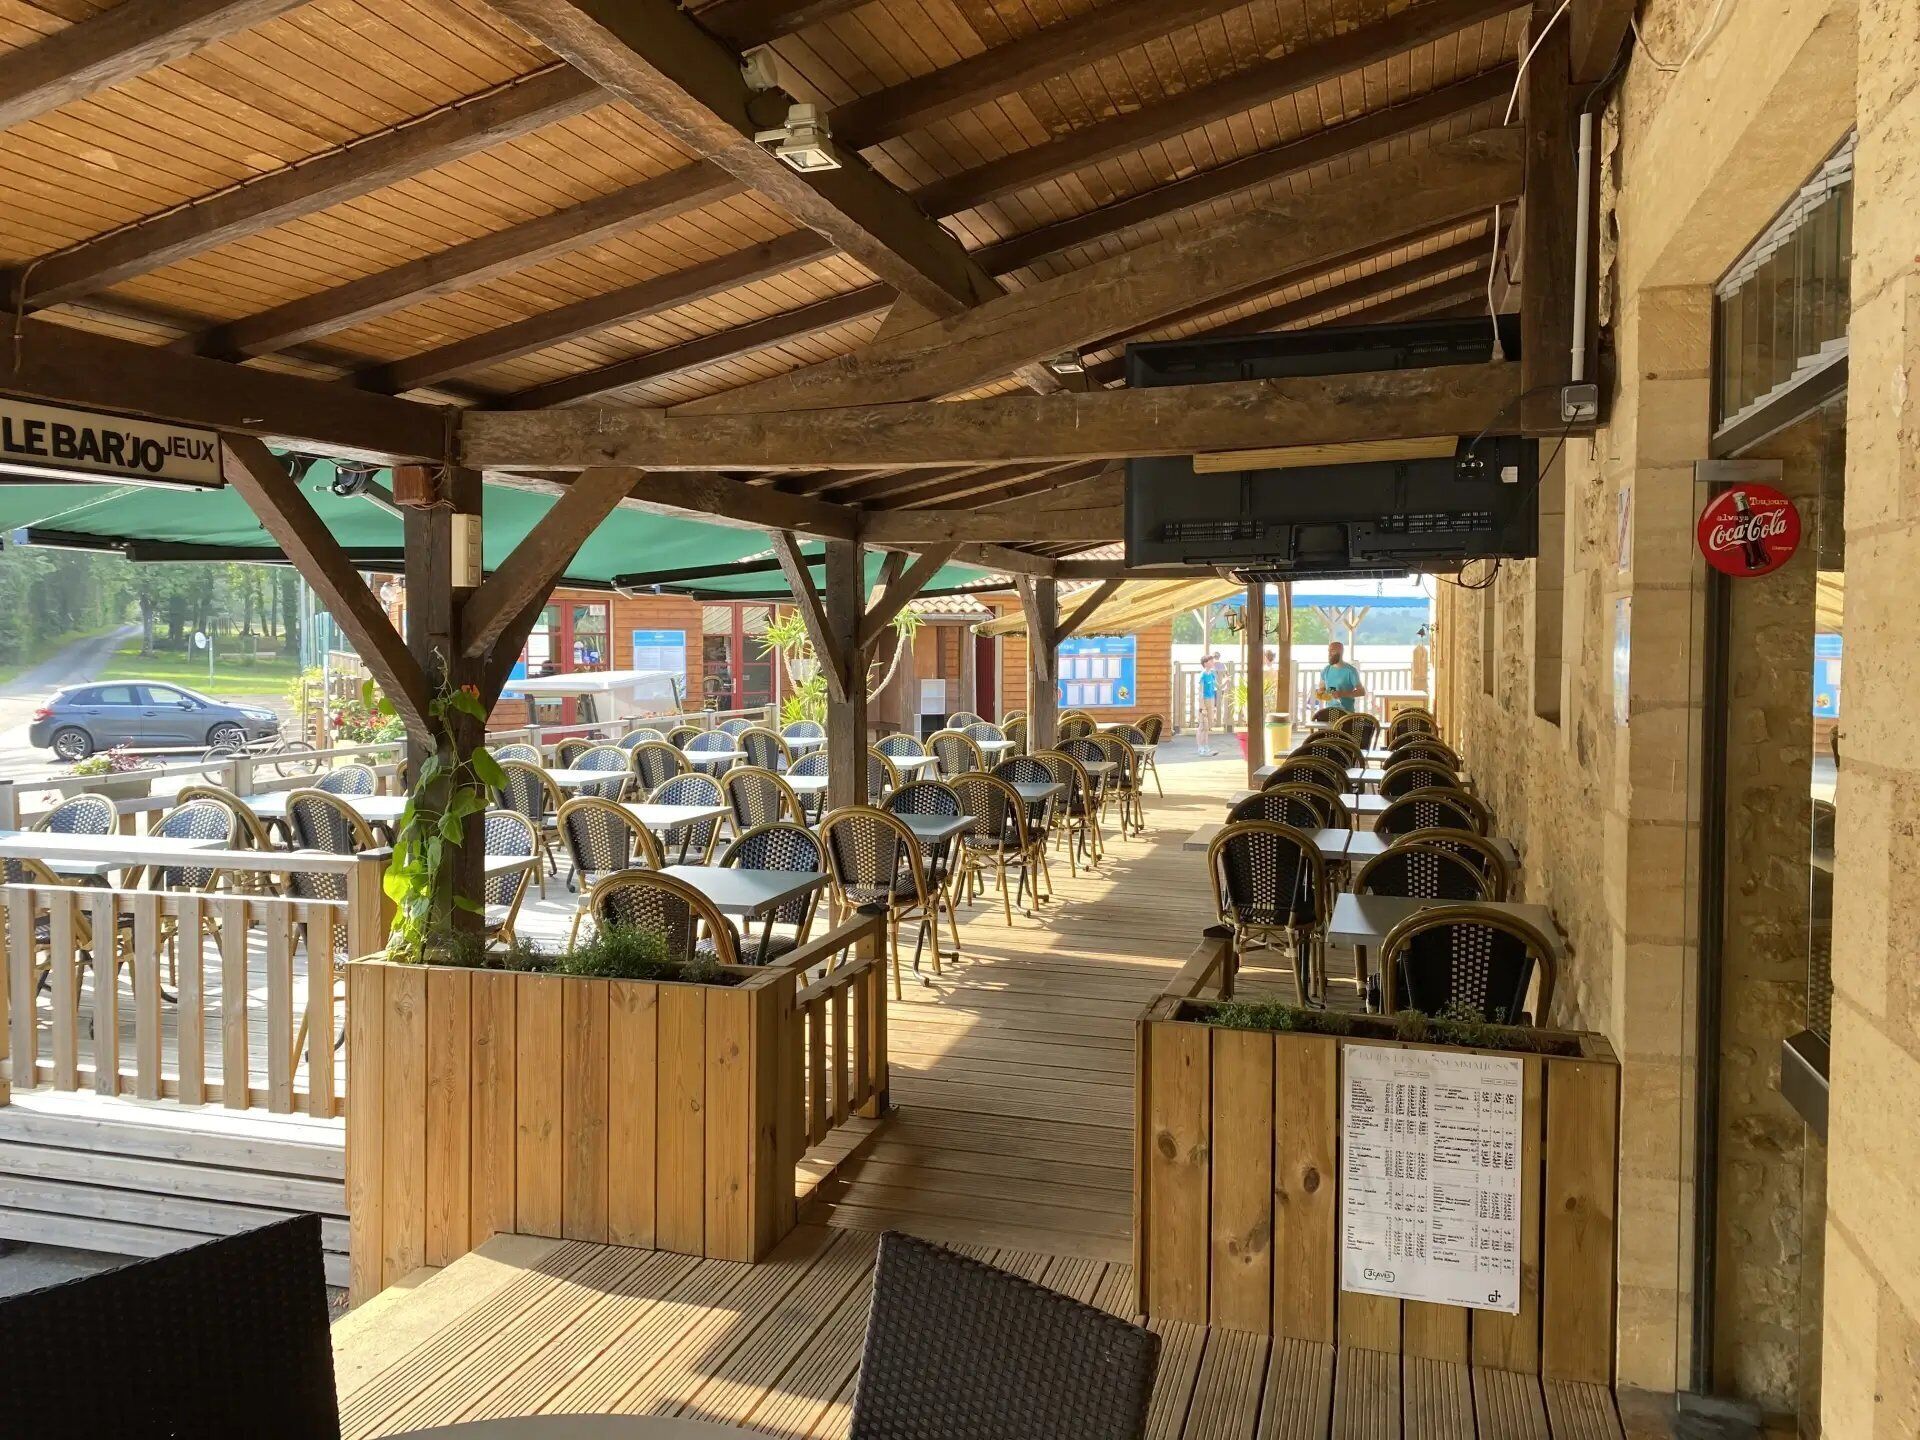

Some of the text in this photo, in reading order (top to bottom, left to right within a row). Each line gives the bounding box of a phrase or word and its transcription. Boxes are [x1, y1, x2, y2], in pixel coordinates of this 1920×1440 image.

[2, 416, 48, 456] LE
[1750, 497, 1789, 506] Toujours
[1709, 508, 1787, 551] Coca-Cola
[1717, 514, 1749, 523] always
